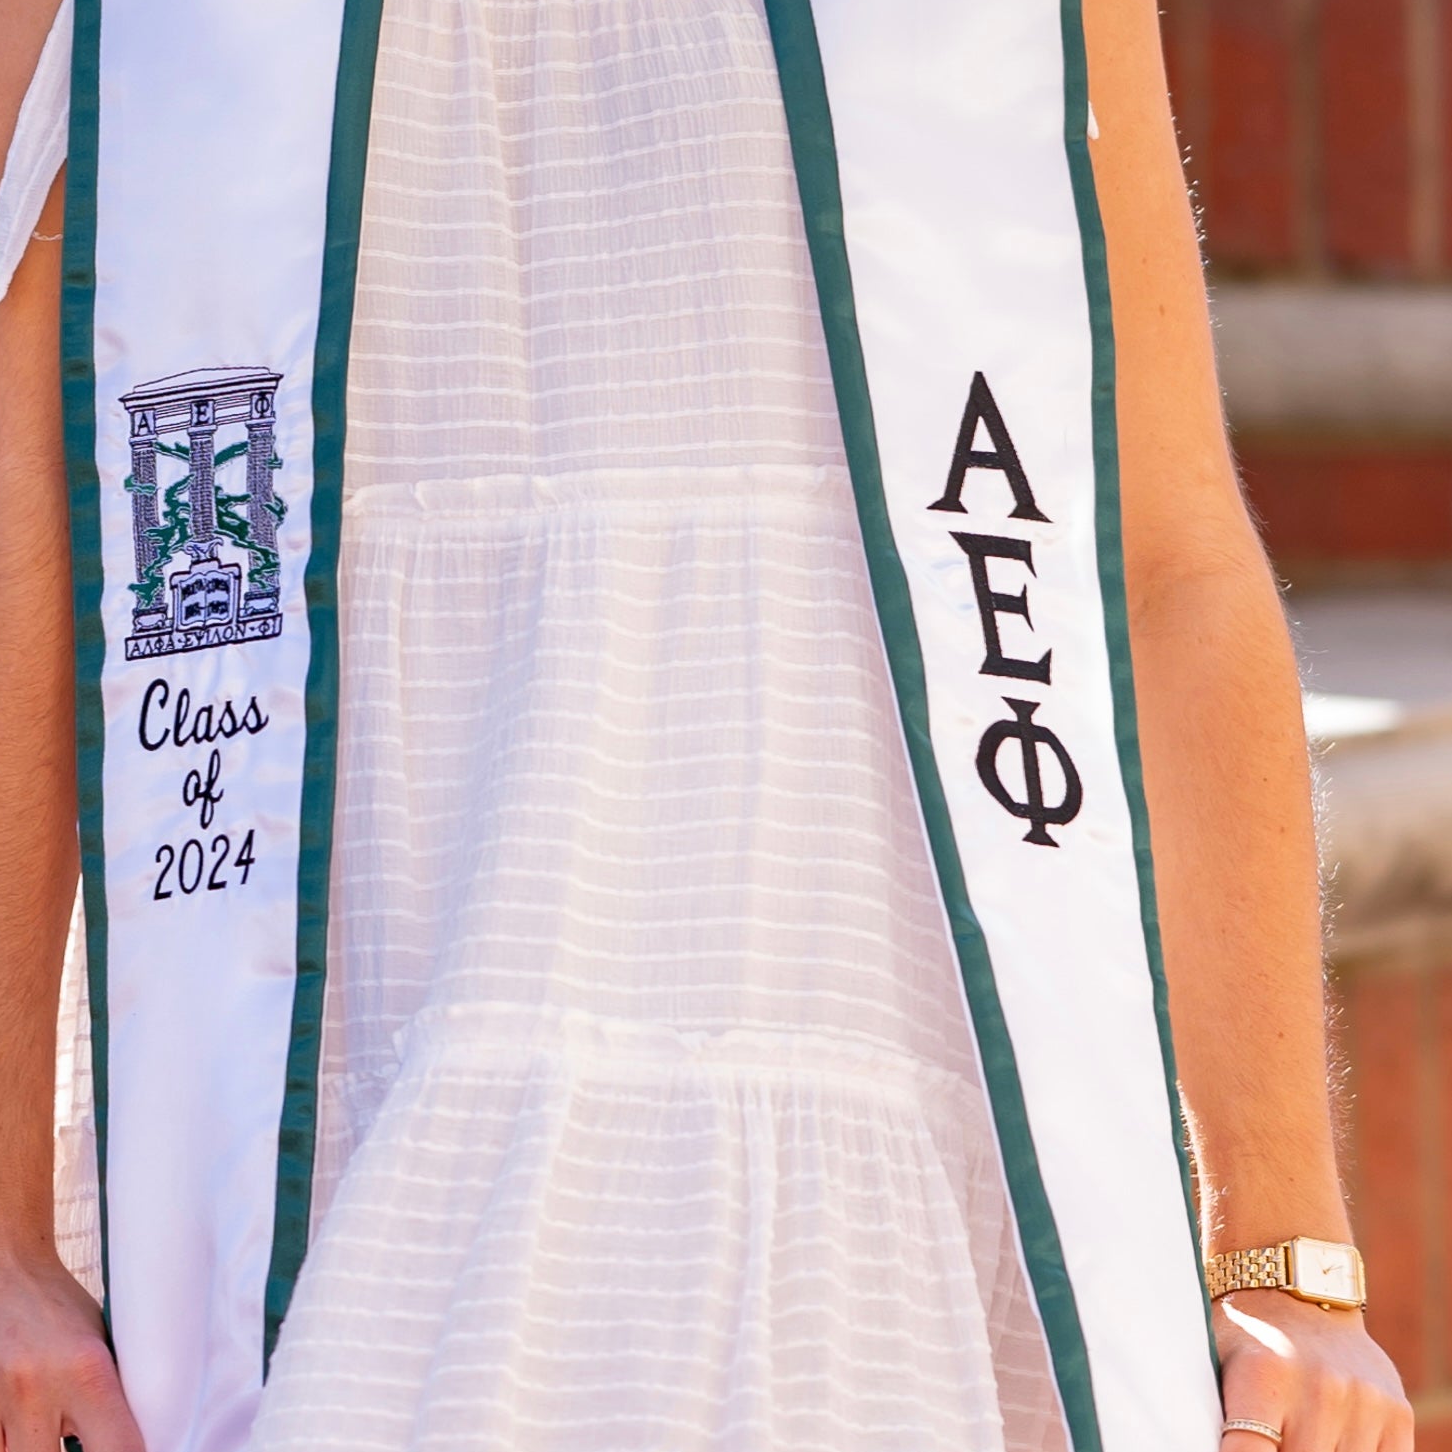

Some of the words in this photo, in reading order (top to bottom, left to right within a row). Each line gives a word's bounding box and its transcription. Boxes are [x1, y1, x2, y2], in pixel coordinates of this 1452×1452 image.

[254, 392, 270, 418] Φ
[139, 678, 269, 751] Class
[182, 748, 224, 830] of
[153, 829, 256, 901] 2024
